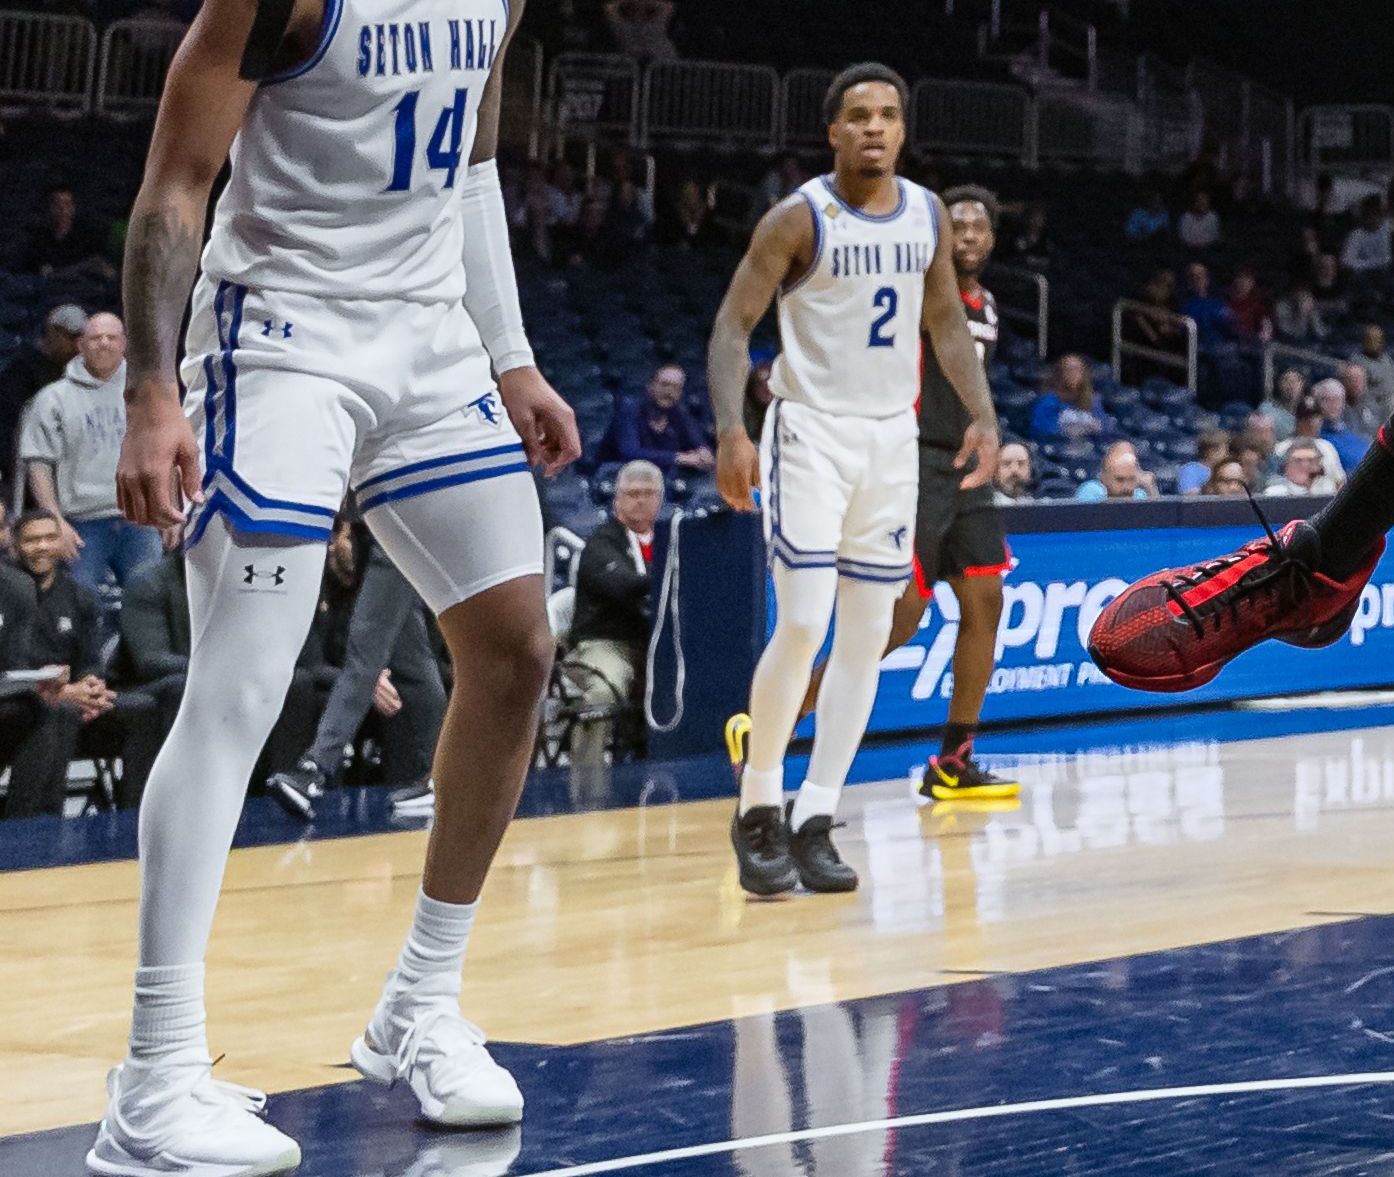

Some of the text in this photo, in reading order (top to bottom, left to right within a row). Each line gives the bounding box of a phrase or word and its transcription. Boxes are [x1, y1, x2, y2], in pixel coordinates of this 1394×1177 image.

[357, 18, 499, 77] SETON HALL
[385, 88, 469, 192] 14
[868, 285, 898, 348] 2
